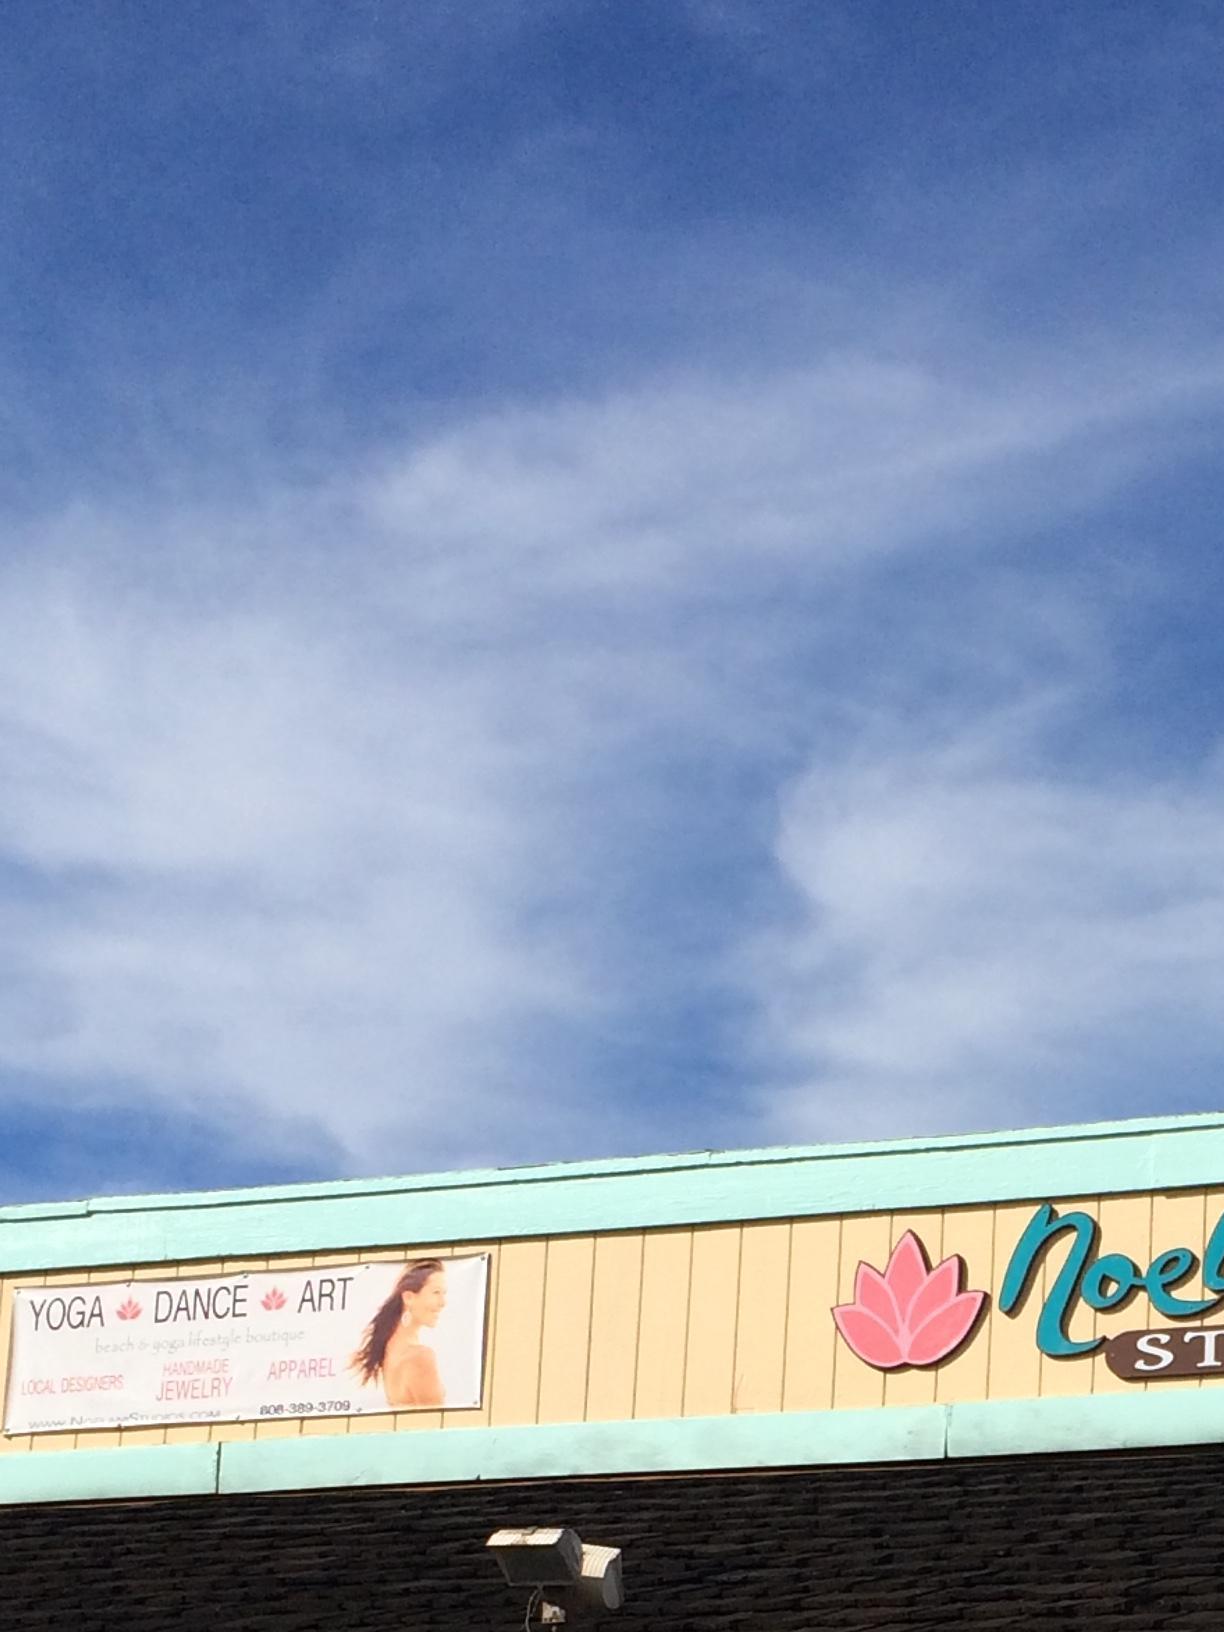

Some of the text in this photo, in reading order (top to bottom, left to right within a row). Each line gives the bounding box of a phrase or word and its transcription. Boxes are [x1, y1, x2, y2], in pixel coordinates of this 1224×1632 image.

[30, 1277, 354, 1331] YOGA DANCE ART
[95, 1335, 135, 1354] beach
[153, 1338, 184, 1355] yoga
[188, 1329, 242, 1352] lifestyle
[246, 1325, 304, 1347] boutique
[163, 1358, 230, 1377] HANDMADE
[267, 1357, 336, 1382] APPAREL
[20, 1374, 124, 1396] LOCAL DESIGNERS
[155, 1376, 233, 1402] JEWELRY
[259, 1400, 351, 1415] 808-389-3709
